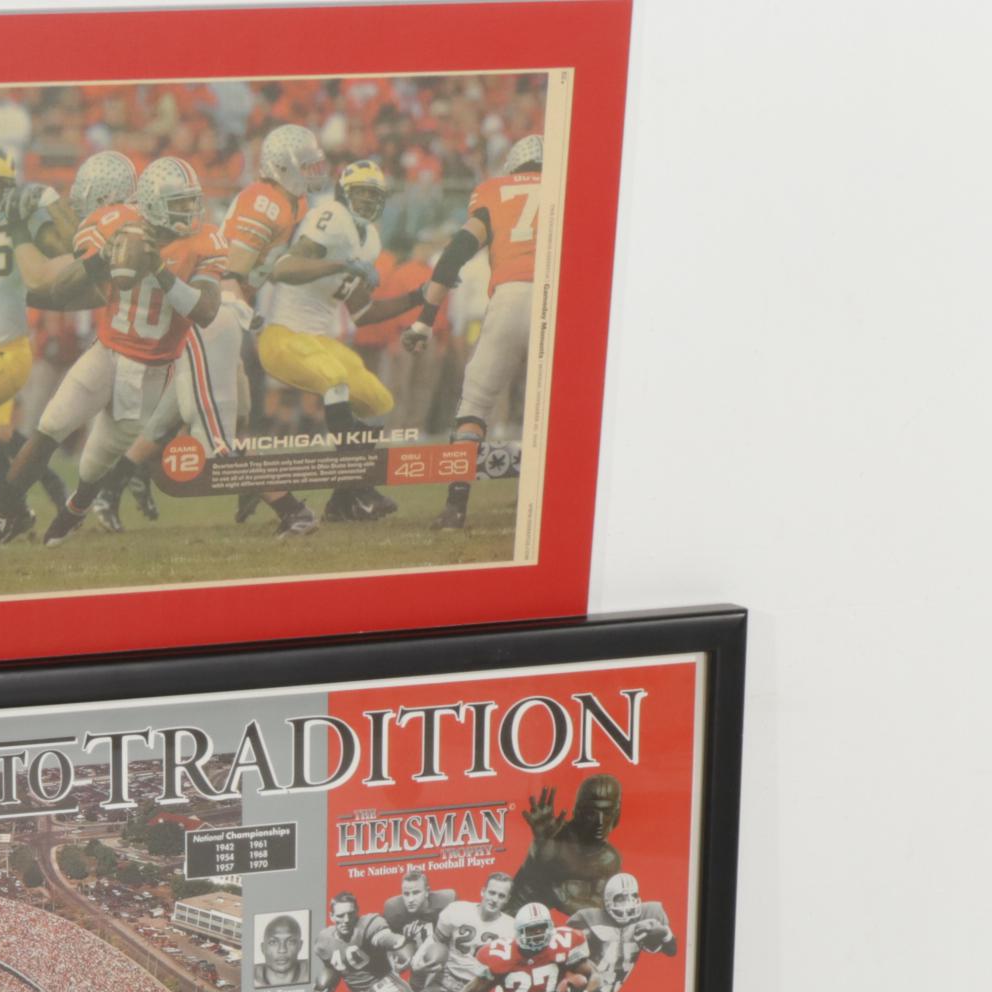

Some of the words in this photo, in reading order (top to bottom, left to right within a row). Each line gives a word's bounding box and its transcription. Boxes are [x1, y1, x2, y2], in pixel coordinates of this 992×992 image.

[315, 211, 332, 233] 2
[111, 273, 175, 340] 10
[232, 433, 343, 450] MICHIGAN
[347, 429, 418, 444] KILLER
[164, 455, 198, 472] 12
[401, 453, 421, 461] OSU
[394, 462, 425, 477] 42
[438, 460, 469, 476] 39
[83, 688, 647, 810] TRADITION
[193, 832, 224, 843] National
[226, 827, 290, 839] Championships
[336, 807, 506, 857] HEISMAN
[250, 840, 267, 848] 1961
[216, 864, 234, 872] 1957
[348, 868, 364, 878] The
[367, 864, 404, 876] Nation's
[428, 858, 465, 871] Football
[467, 857, 495, 869] Player
